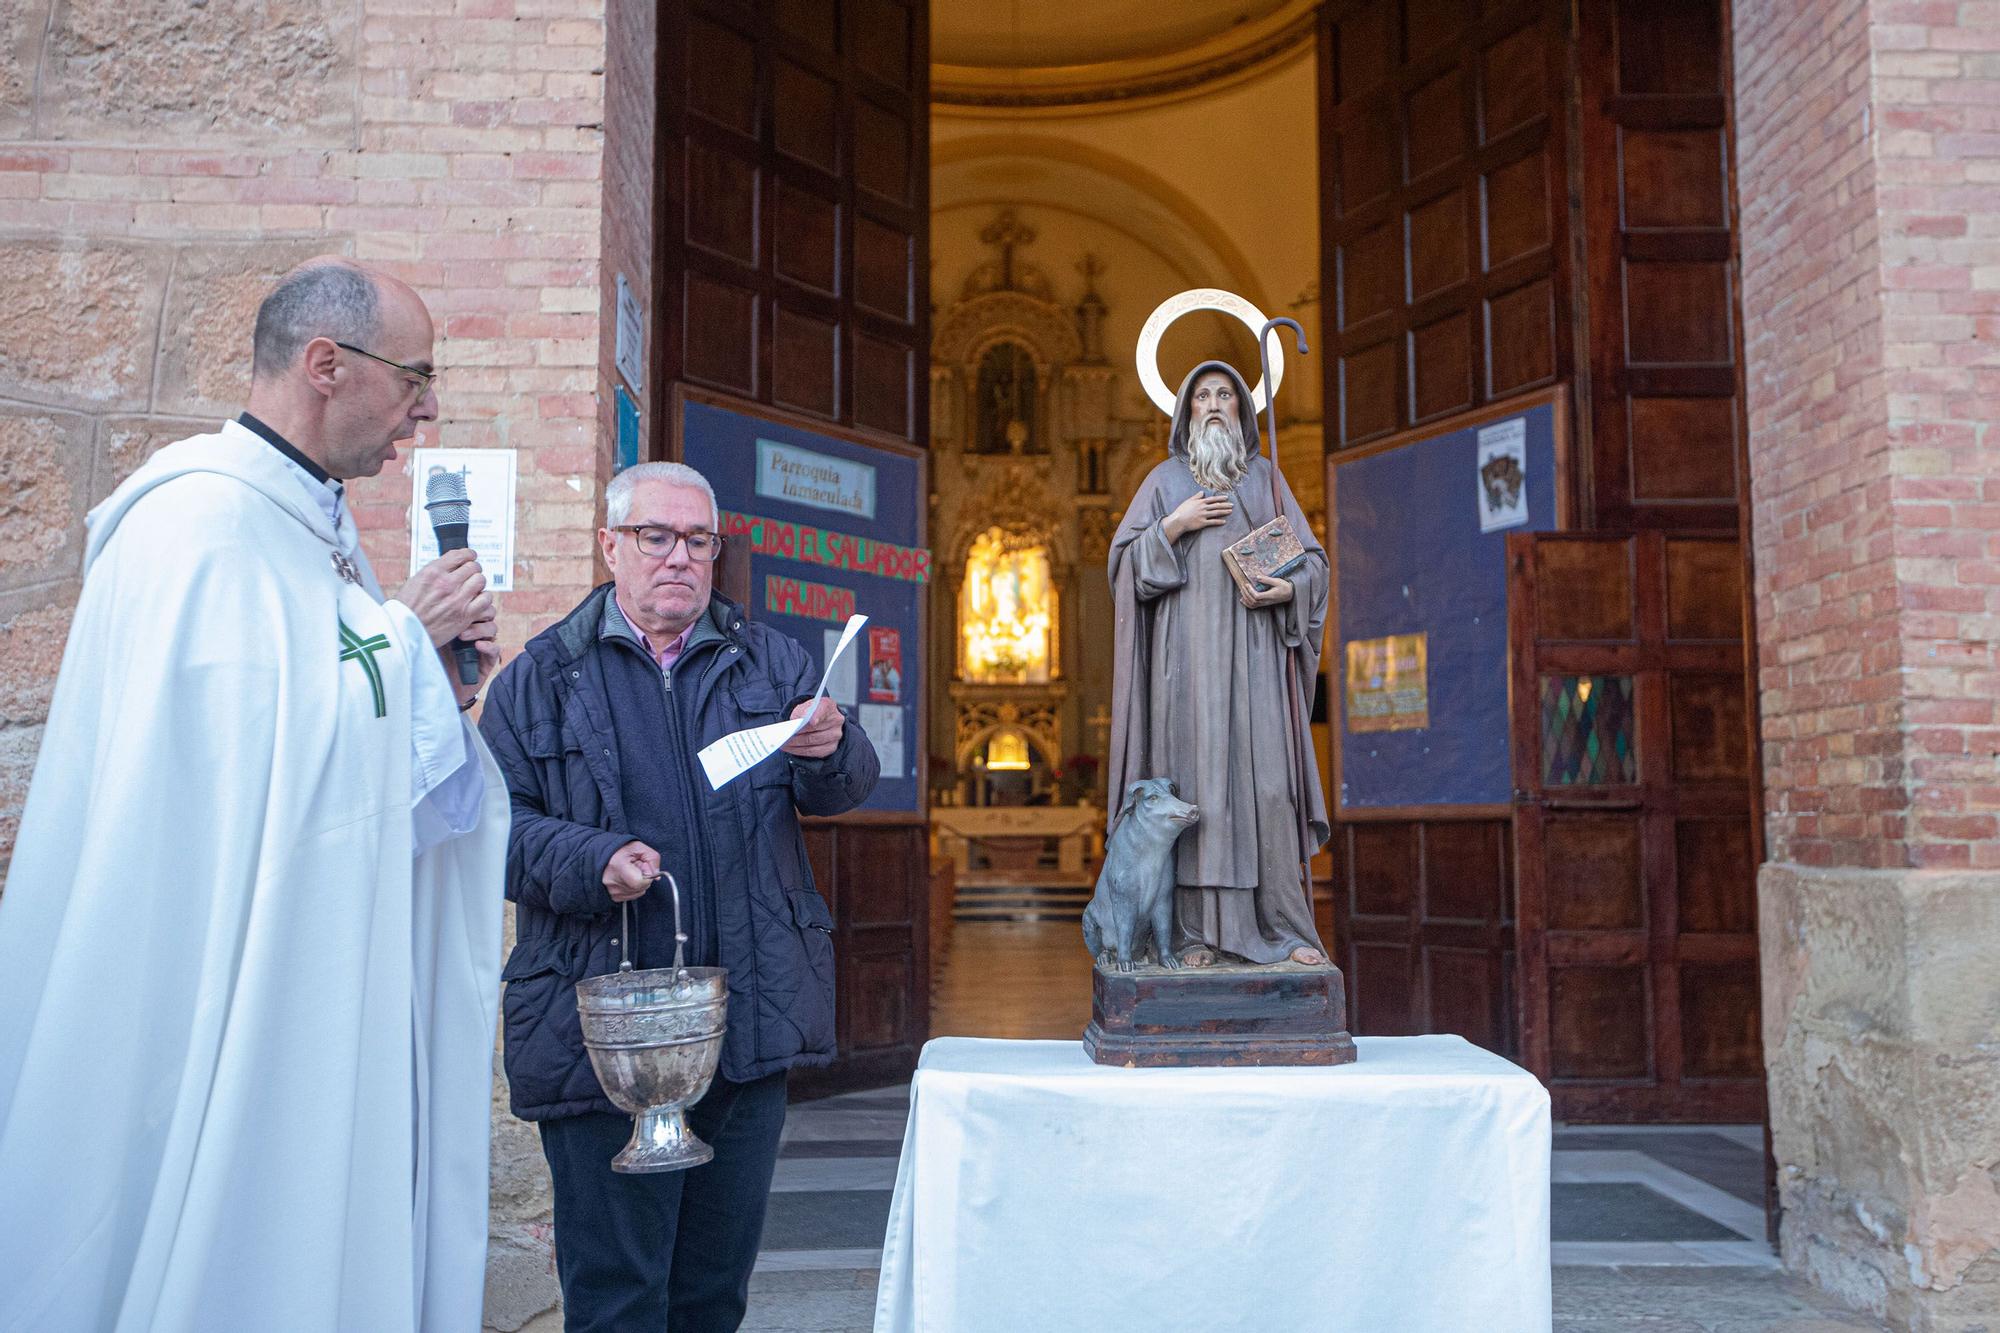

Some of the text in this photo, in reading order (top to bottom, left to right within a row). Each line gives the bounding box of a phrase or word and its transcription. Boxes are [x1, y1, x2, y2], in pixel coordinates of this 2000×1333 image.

[771, 451, 840, 483] Parroquia
[799, 526, 823, 563] EL
[826, 531, 929, 582] SALVADOR
[767, 575, 855, 623] NAVIDAD
